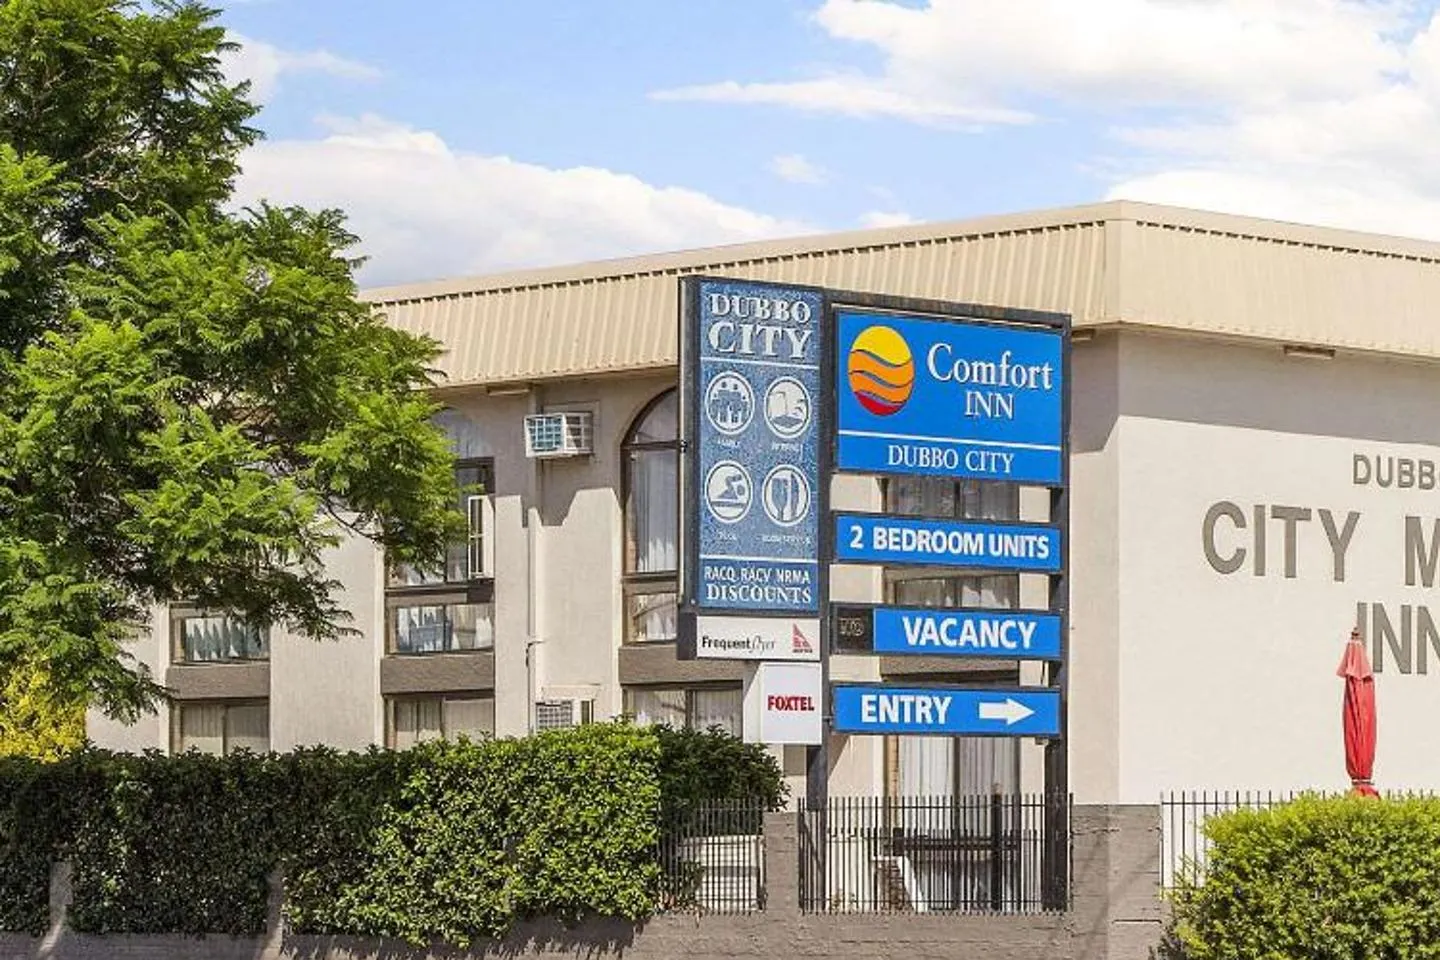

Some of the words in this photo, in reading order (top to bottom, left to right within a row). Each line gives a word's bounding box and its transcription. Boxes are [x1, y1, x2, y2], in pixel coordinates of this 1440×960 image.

[709, 293, 812, 324] DUBBO
[708, 321, 813, 359] CITY
[927, 342, 1053, 390] Comfort
[964, 389, 1014, 419] INN
[888, 444, 959, 470] DUBBO
[965, 450, 1014, 474] CITY
[850, 525, 864, 549] 2
[873, 526, 984, 556] BEDROOM
[989, 532, 1049, 559] UNITS
[1202, 501, 1361, 582] CITY
[706, 583, 811, 604] DISCOUNTS
[702, 636, 750, 651] Frequent
[902, 616, 1037, 649] VACANCY
[767, 695, 815, 711] FOXTEL
[861, 695, 952, 725] ENTRY
